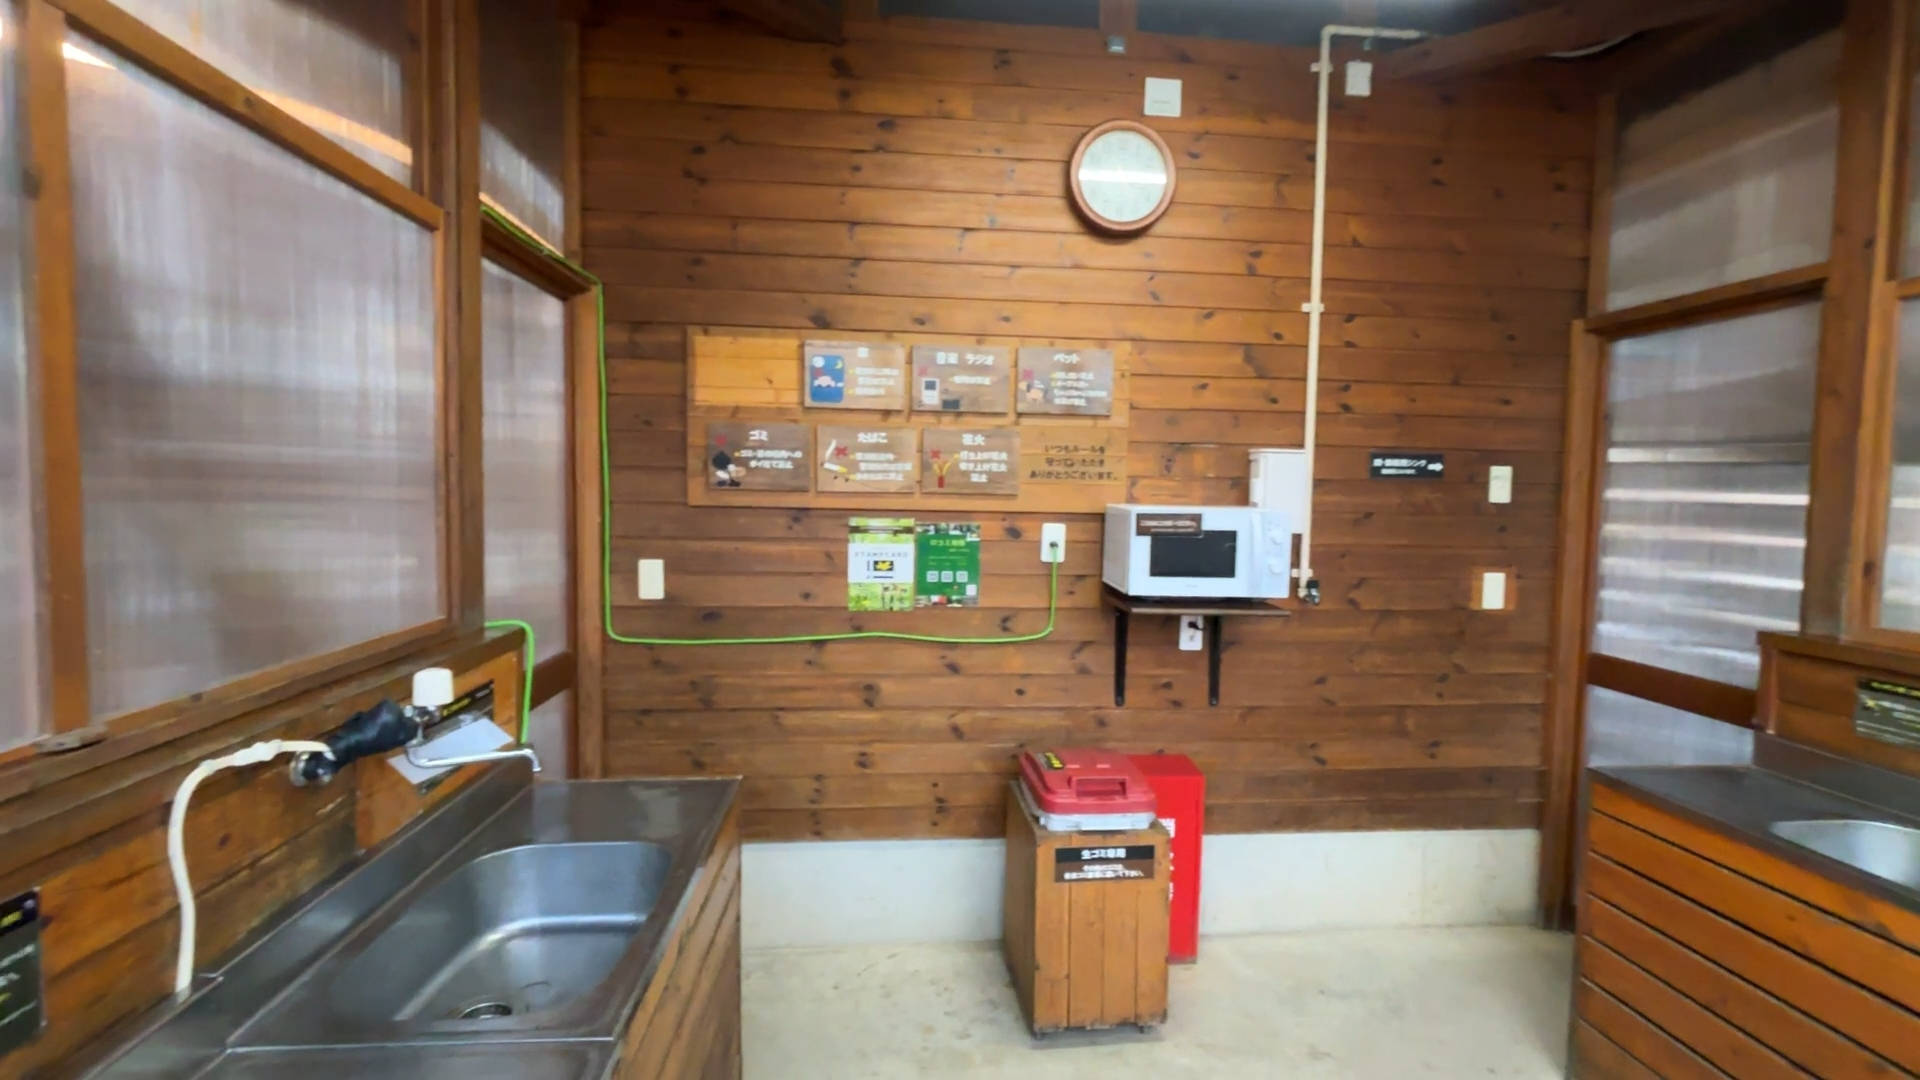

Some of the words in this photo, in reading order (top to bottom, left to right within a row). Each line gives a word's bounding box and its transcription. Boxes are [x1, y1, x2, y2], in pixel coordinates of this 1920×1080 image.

[1053, 353, 1080, 364] ペット
[749, 430, 768, 441] ゴミ
[857, 432, 888, 443] たばこ
